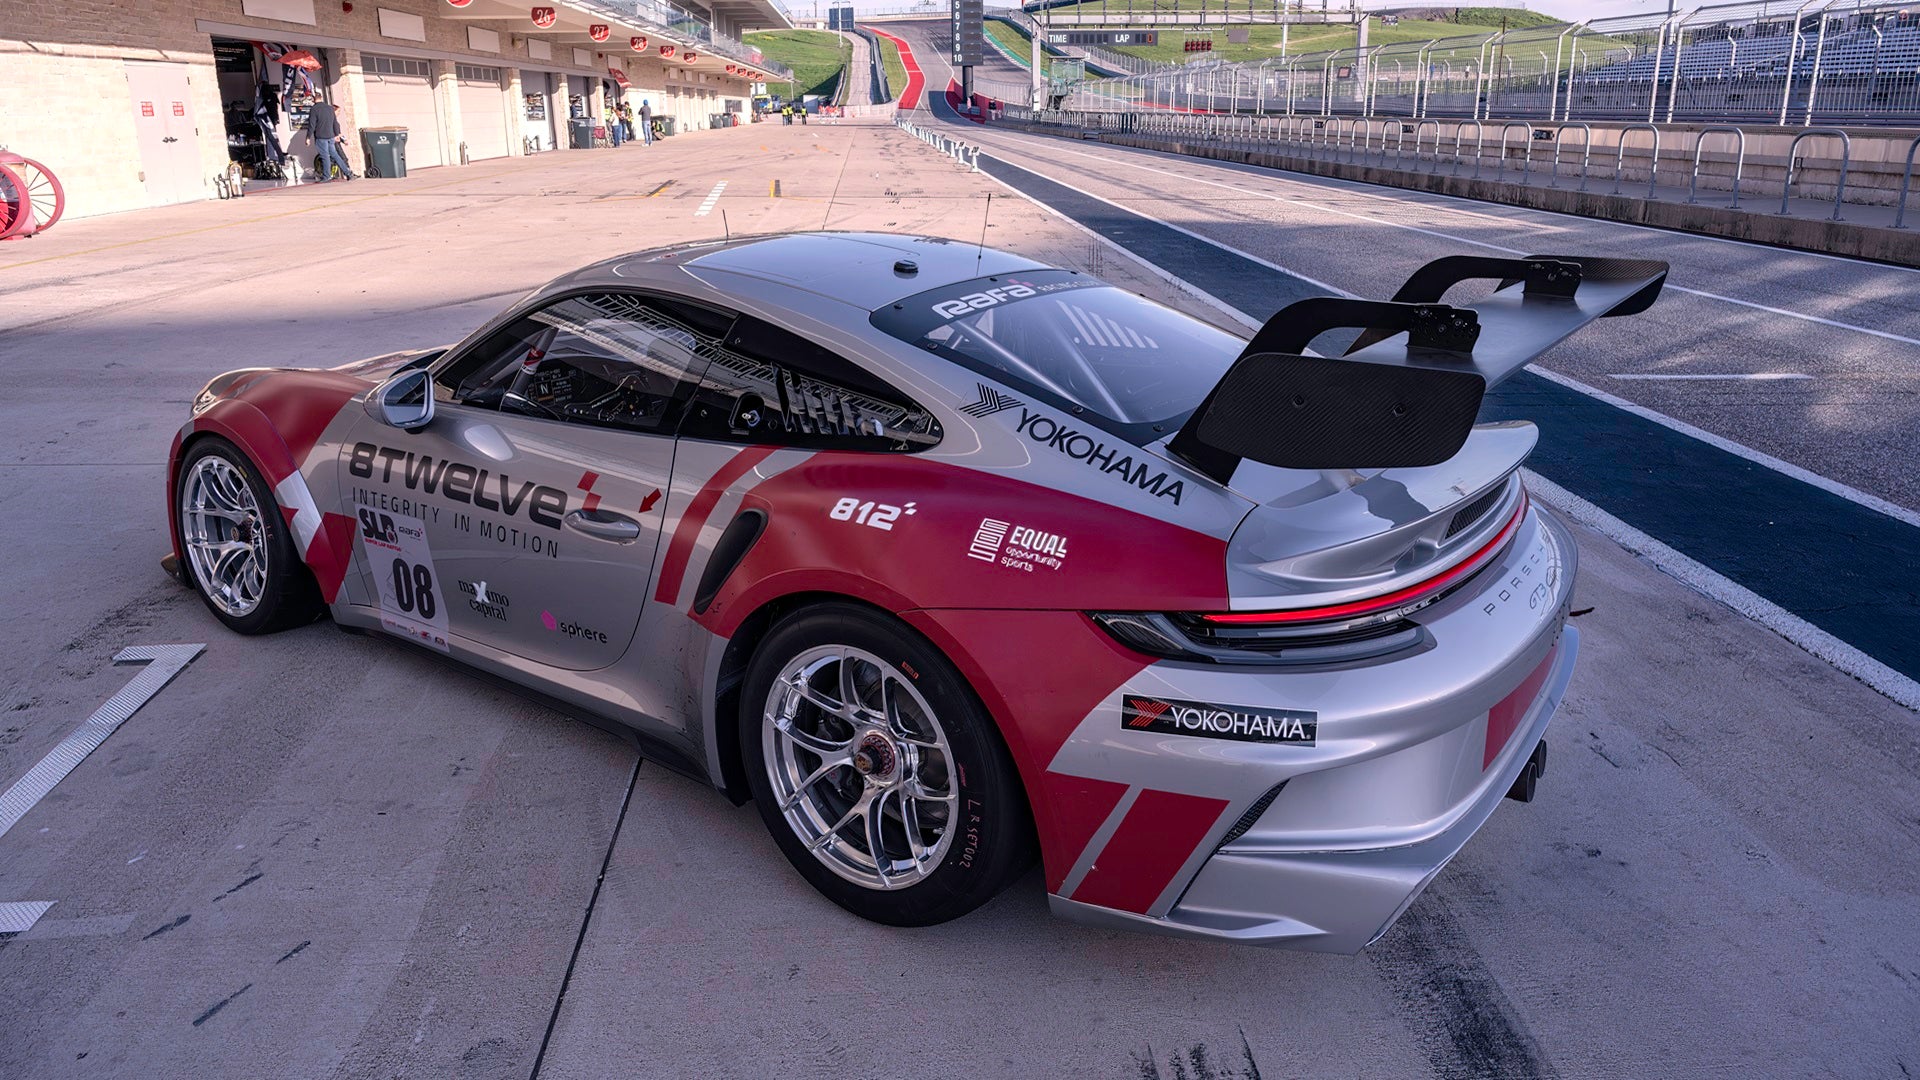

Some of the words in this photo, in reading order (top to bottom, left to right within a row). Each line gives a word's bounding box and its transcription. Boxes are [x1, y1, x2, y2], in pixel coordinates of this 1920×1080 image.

[955, 0, 960, 9] 5
[537, 9, 551, 23] 26
[955, 11, 960, 20] 6
[594, 26, 605, 38] 27
[955, 22, 960, 30] 7
[633, 38, 644, 49] 28
[955, 33, 961, 41] 8
[1048, 34, 1067, 43] TIME
[1115, 34, 1130, 43] LAP
[955, 43, 961, 51] 9
[953, 53, 962, 62] 10
[1016, 408, 1184, 506] YOKOHAMA
[829, 497, 902, 531] 812
[352, 486, 440, 524] INTEGRITY
[454, 513, 470, 533] IN
[480, 520, 559, 559] MOTION
[1009, 525, 1067, 558] EQUAL
[1001, 556, 1034, 573] sports
[392, 558, 436, 619] 08
[469, 599, 507, 622] capital
[560, 621, 608, 644] sphere
[1171, 706, 1307, 740] YOKOHAMA
